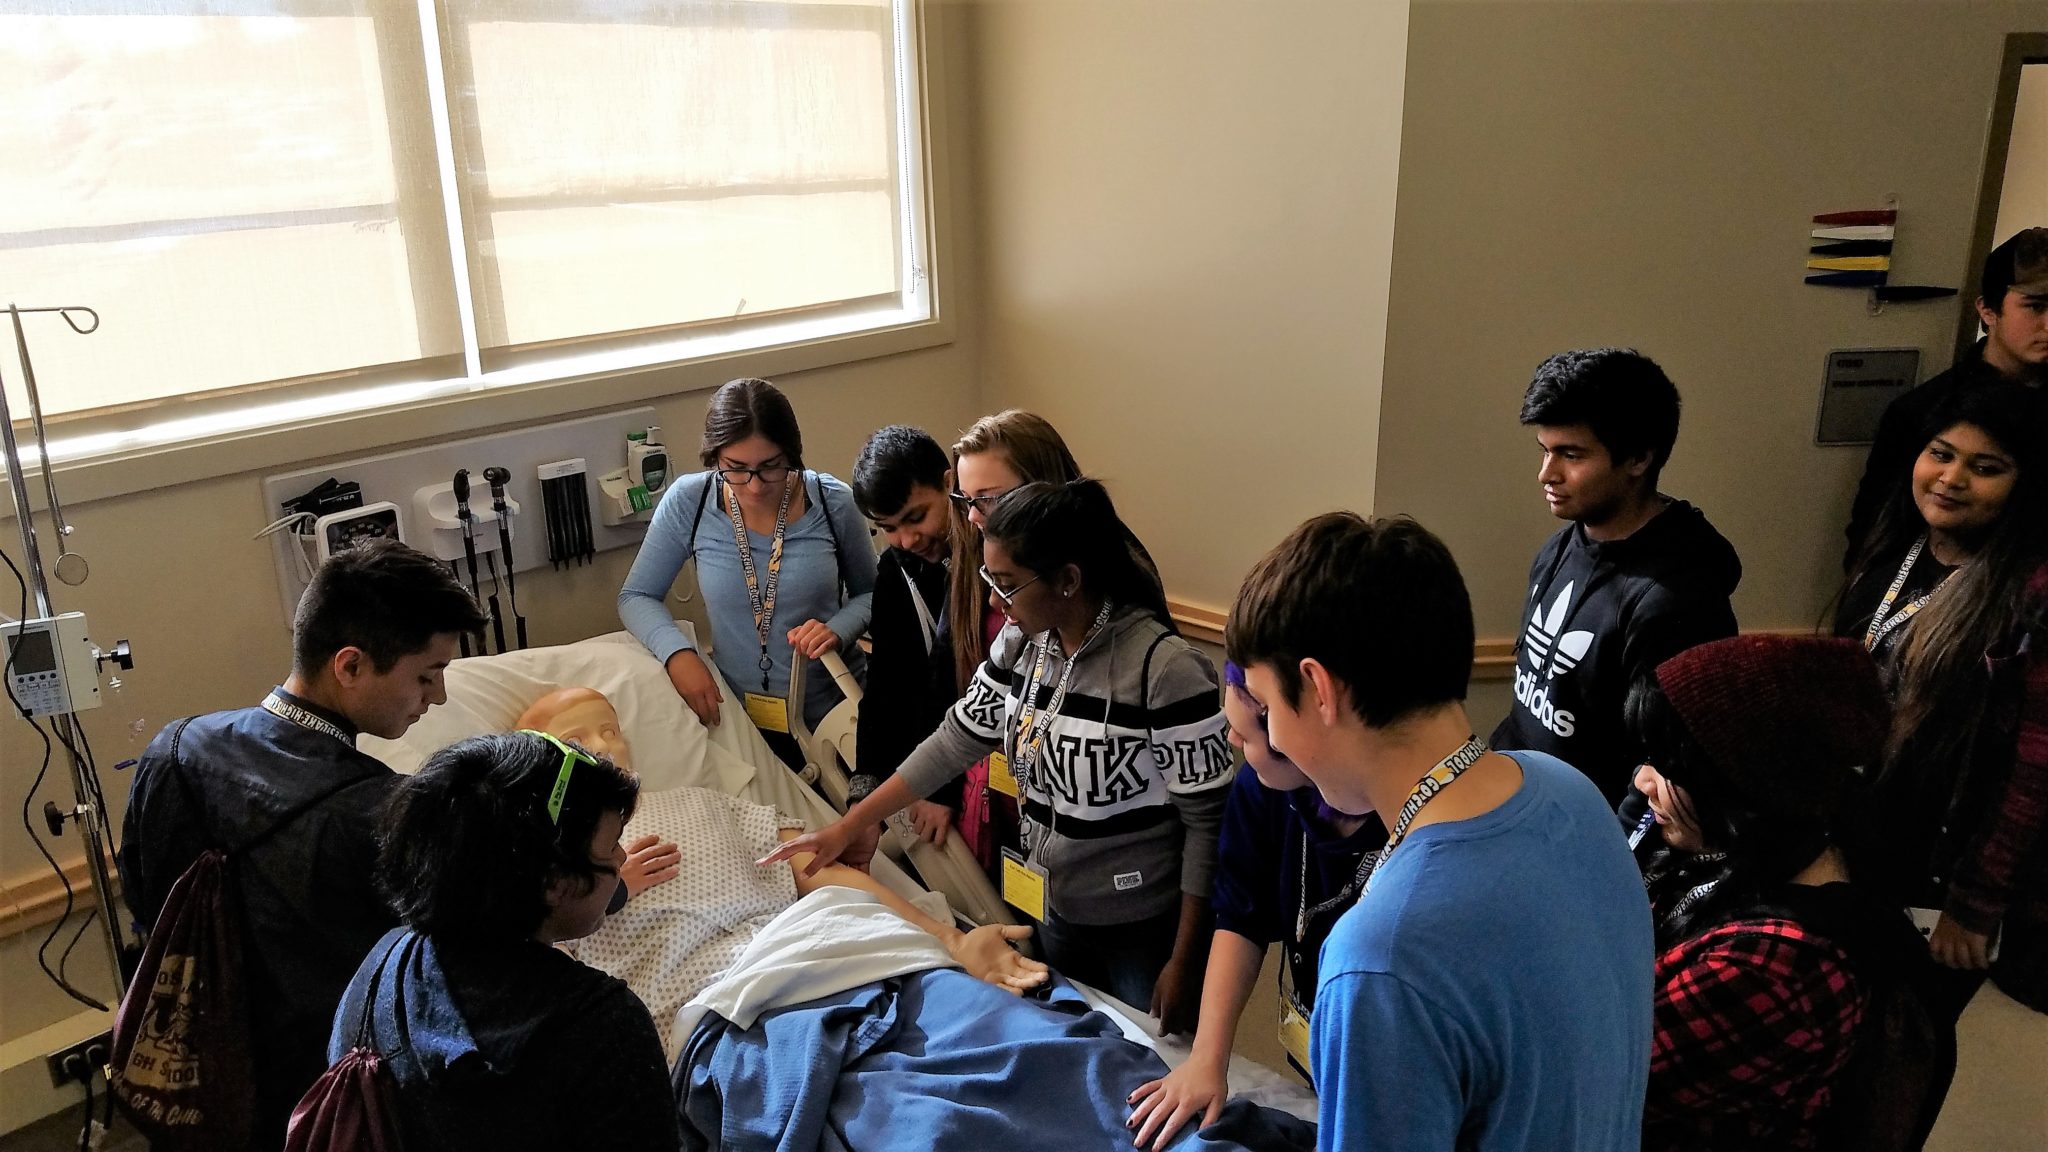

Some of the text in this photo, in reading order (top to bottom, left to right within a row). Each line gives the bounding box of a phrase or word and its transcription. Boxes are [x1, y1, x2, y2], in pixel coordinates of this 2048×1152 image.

[741, 553, 753, 578] SCHOOL
[1888, 565, 1909, 592] SCHOOL
[1868, 609, 1887, 634] CHIEFS
[1881, 609, 1909, 634] SCHOOL
[281, 703, 302, 721] HIGH
[1025, 687, 1038, 716] CHIEFS
[304, 713, 328, 734] LAKE
[1034, 710, 1052, 738] SCHOOL
[1445, 741, 1482, 774] SCHOOL
[1395, 776, 1440, 836] GO CHIEFS
